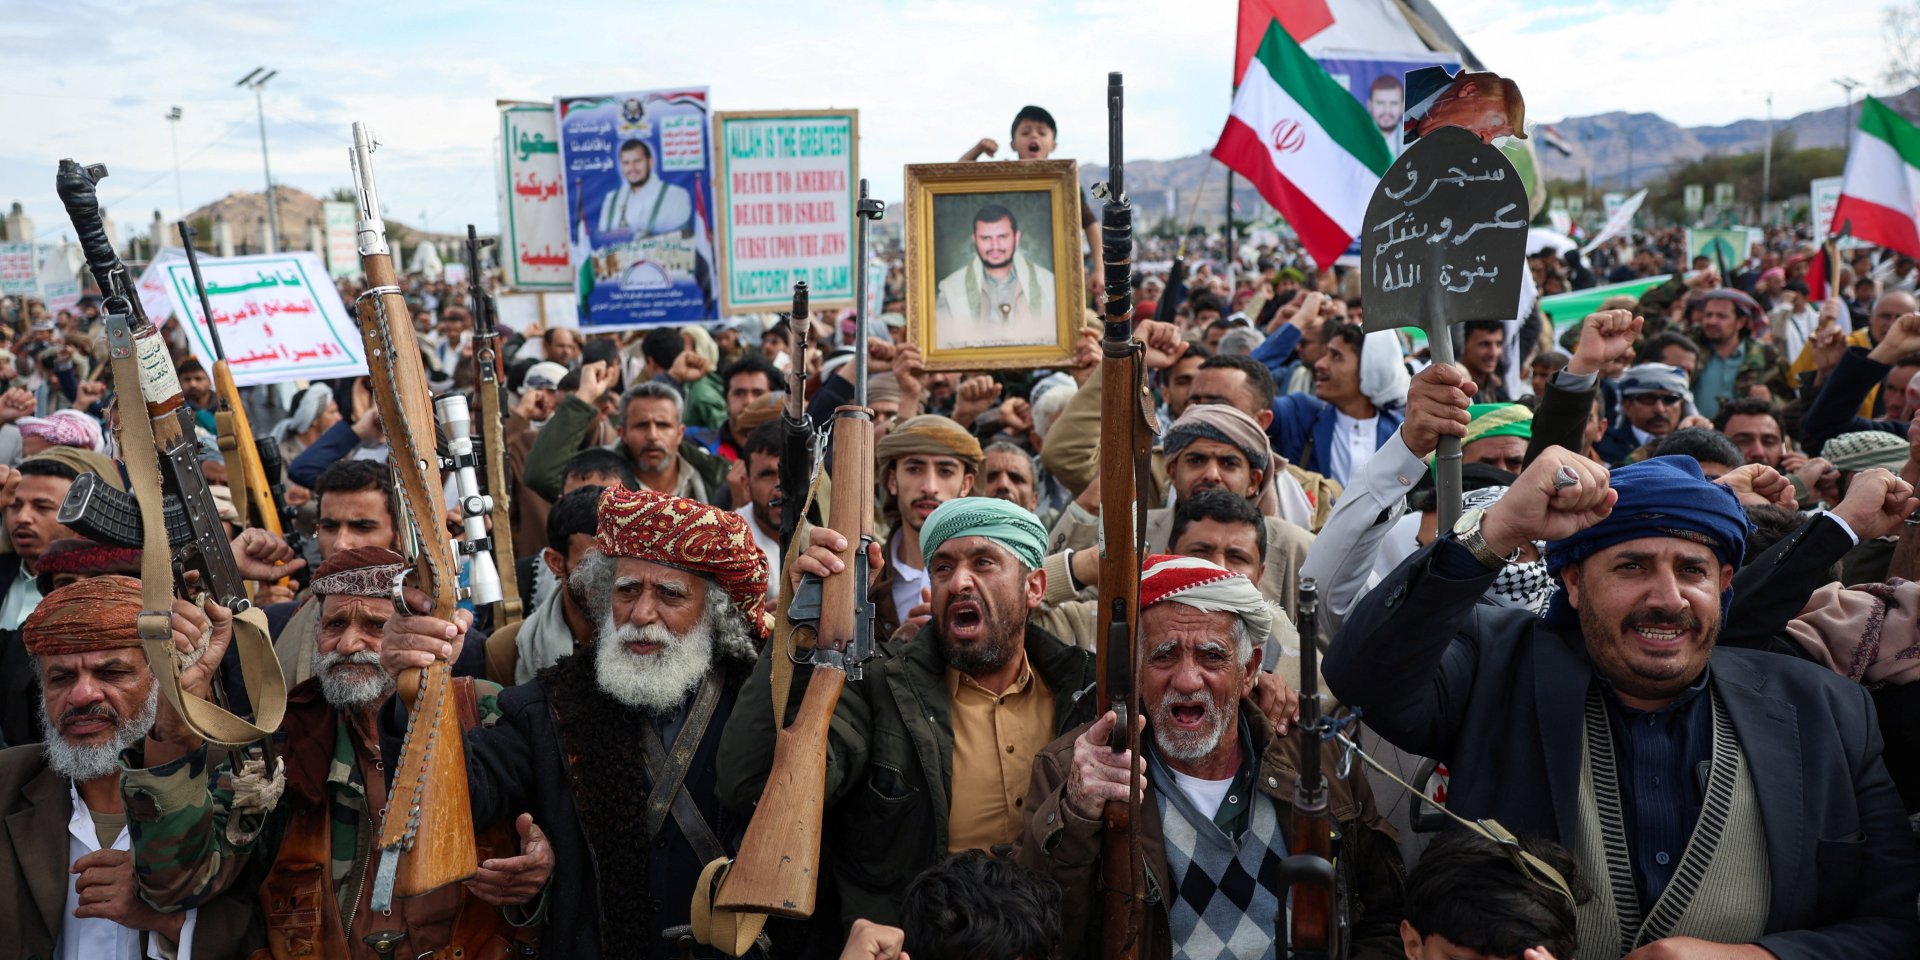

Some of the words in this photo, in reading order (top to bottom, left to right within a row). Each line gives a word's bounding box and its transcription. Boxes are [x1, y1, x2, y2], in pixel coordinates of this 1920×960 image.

[731, 127, 763, 159] ALLAH
[765, 127, 775, 158] IS
[777, 126, 797, 158] THE
[799, 125, 849, 157] GREATEST
[733, 171, 773, 194] DEATH
[776, 171, 792, 194] TO
[796, 169, 846, 193] AMERICA
[1385, 157, 1505, 207] سنجرف
[734, 203, 774, 226] DEATH
[777, 202, 793, 225] TO
[795, 201, 837, 224] ISRAEL
[735, 236, 768, 260] CURSE
[769, 235, 797, 259] UPON
[799, 235, 818, 257] THE
[821, 232, 846, 257] JEWS
[736, 268, 790, 296] VICTORY
[812, 266, 849, 291] ISLAM
[1440, 255, 1499, 292] بقوة
[196, 301, 261, 326] الأمريكة
[263, 324, 273, 337] و
